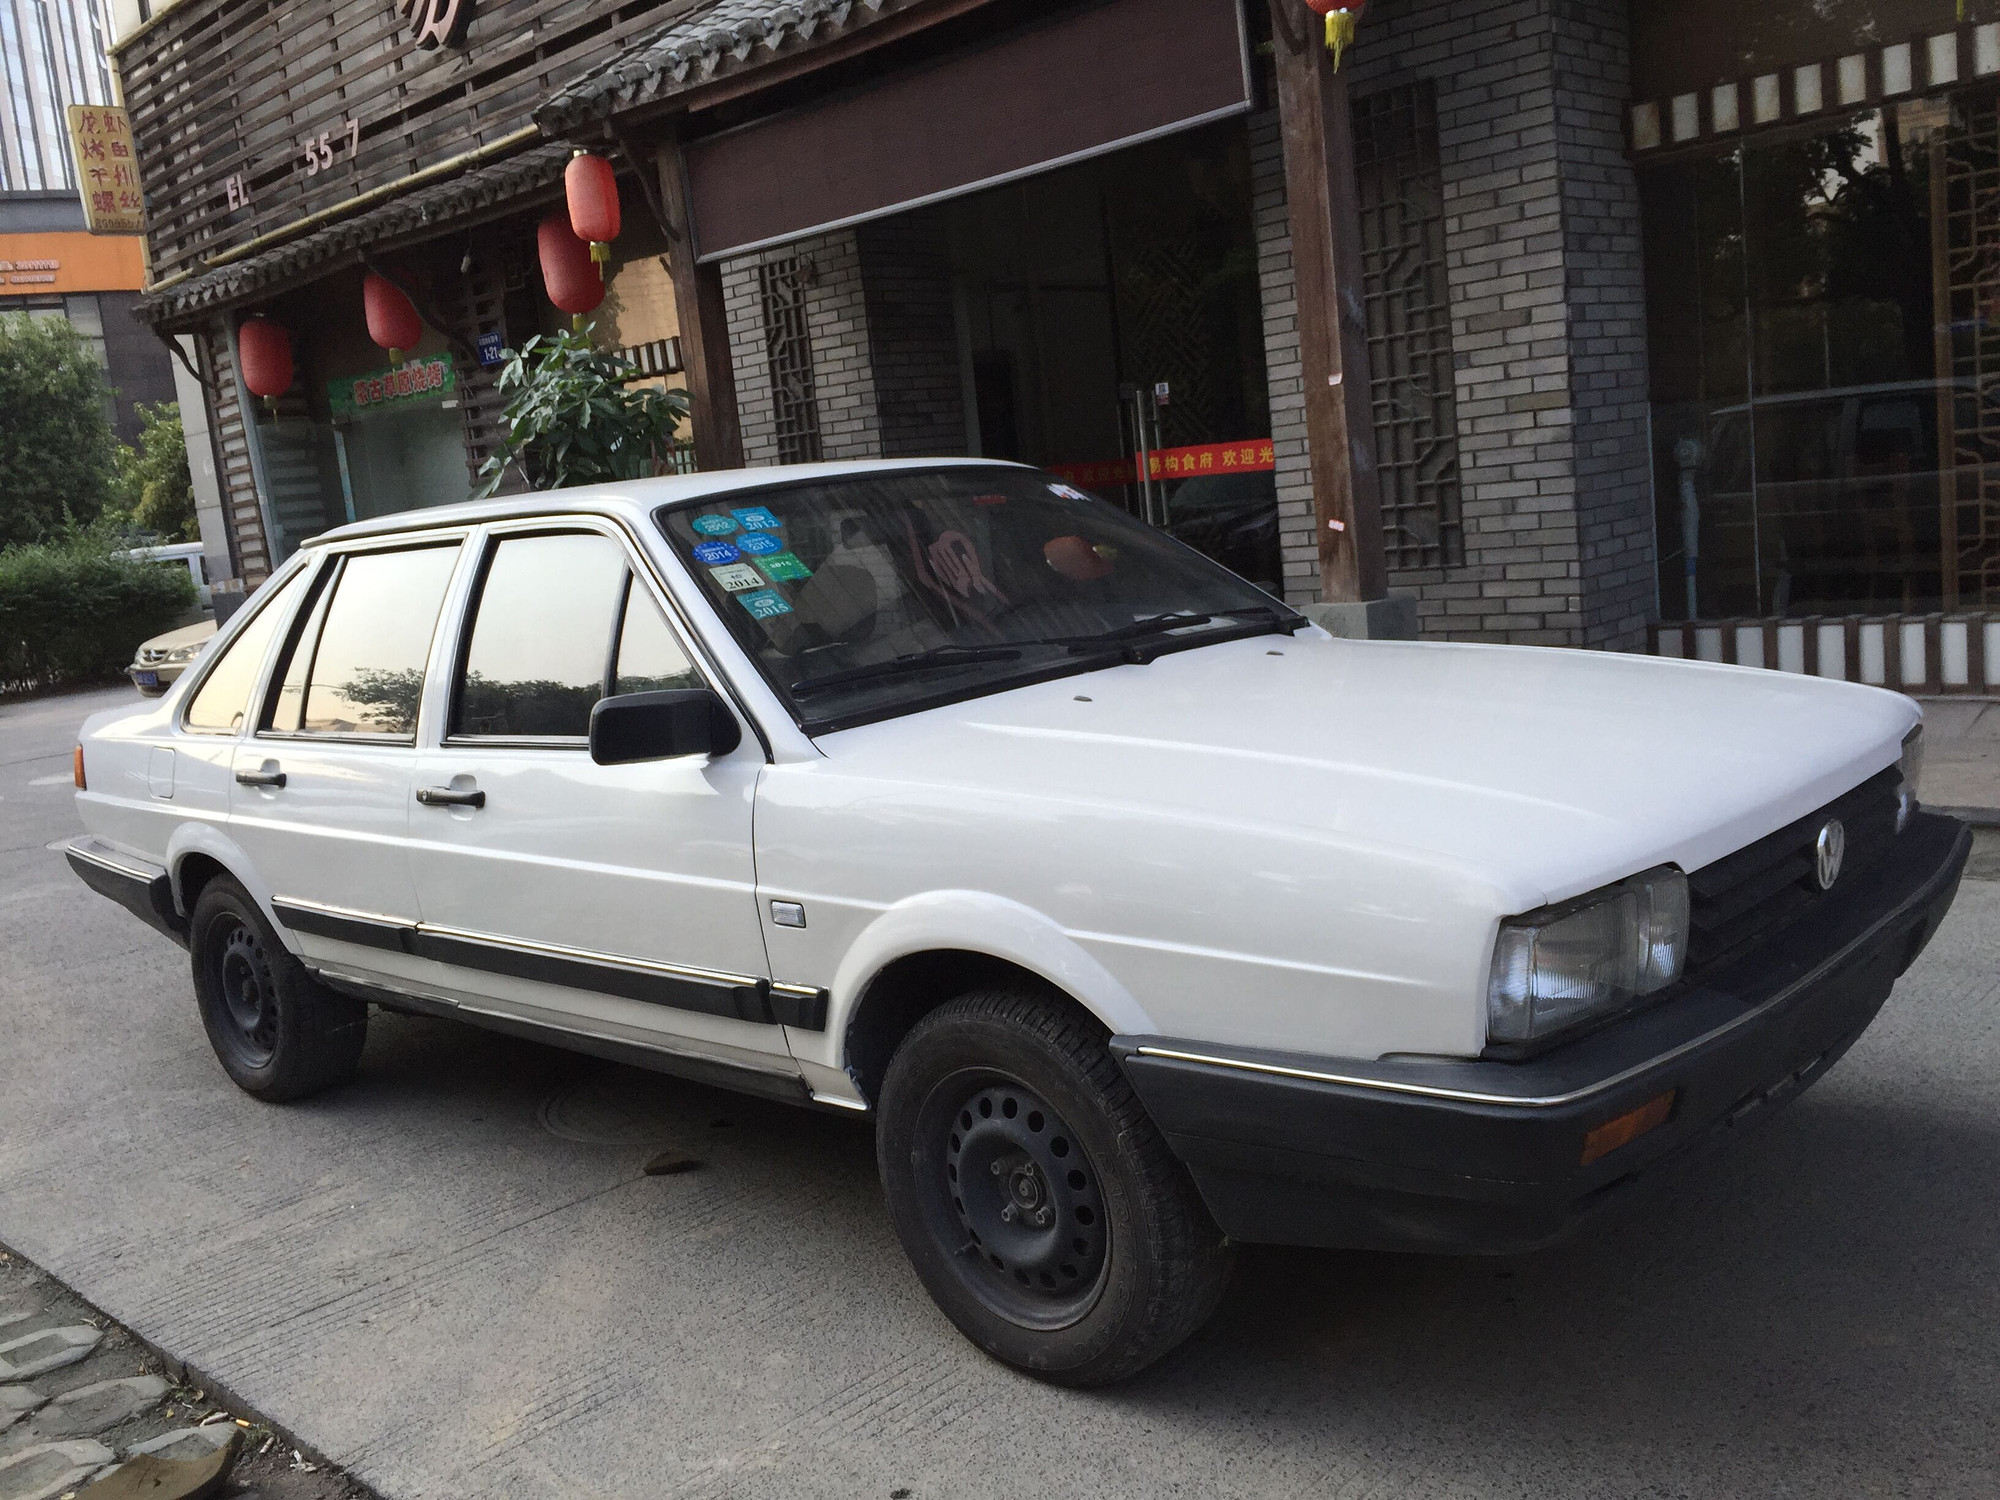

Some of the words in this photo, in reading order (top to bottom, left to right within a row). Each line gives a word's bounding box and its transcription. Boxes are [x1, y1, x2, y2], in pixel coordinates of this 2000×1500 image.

[226, 173, 249, 212] EL
[705, 521, 730, 532] 2012
[746, 520, 778, 530] 2012
[749, 540, 775, 551] 2015
[705, 549, 732, 561] 2014
[726, 577, 759, 589] 2014
[755, 603, 788, 617] 2015
